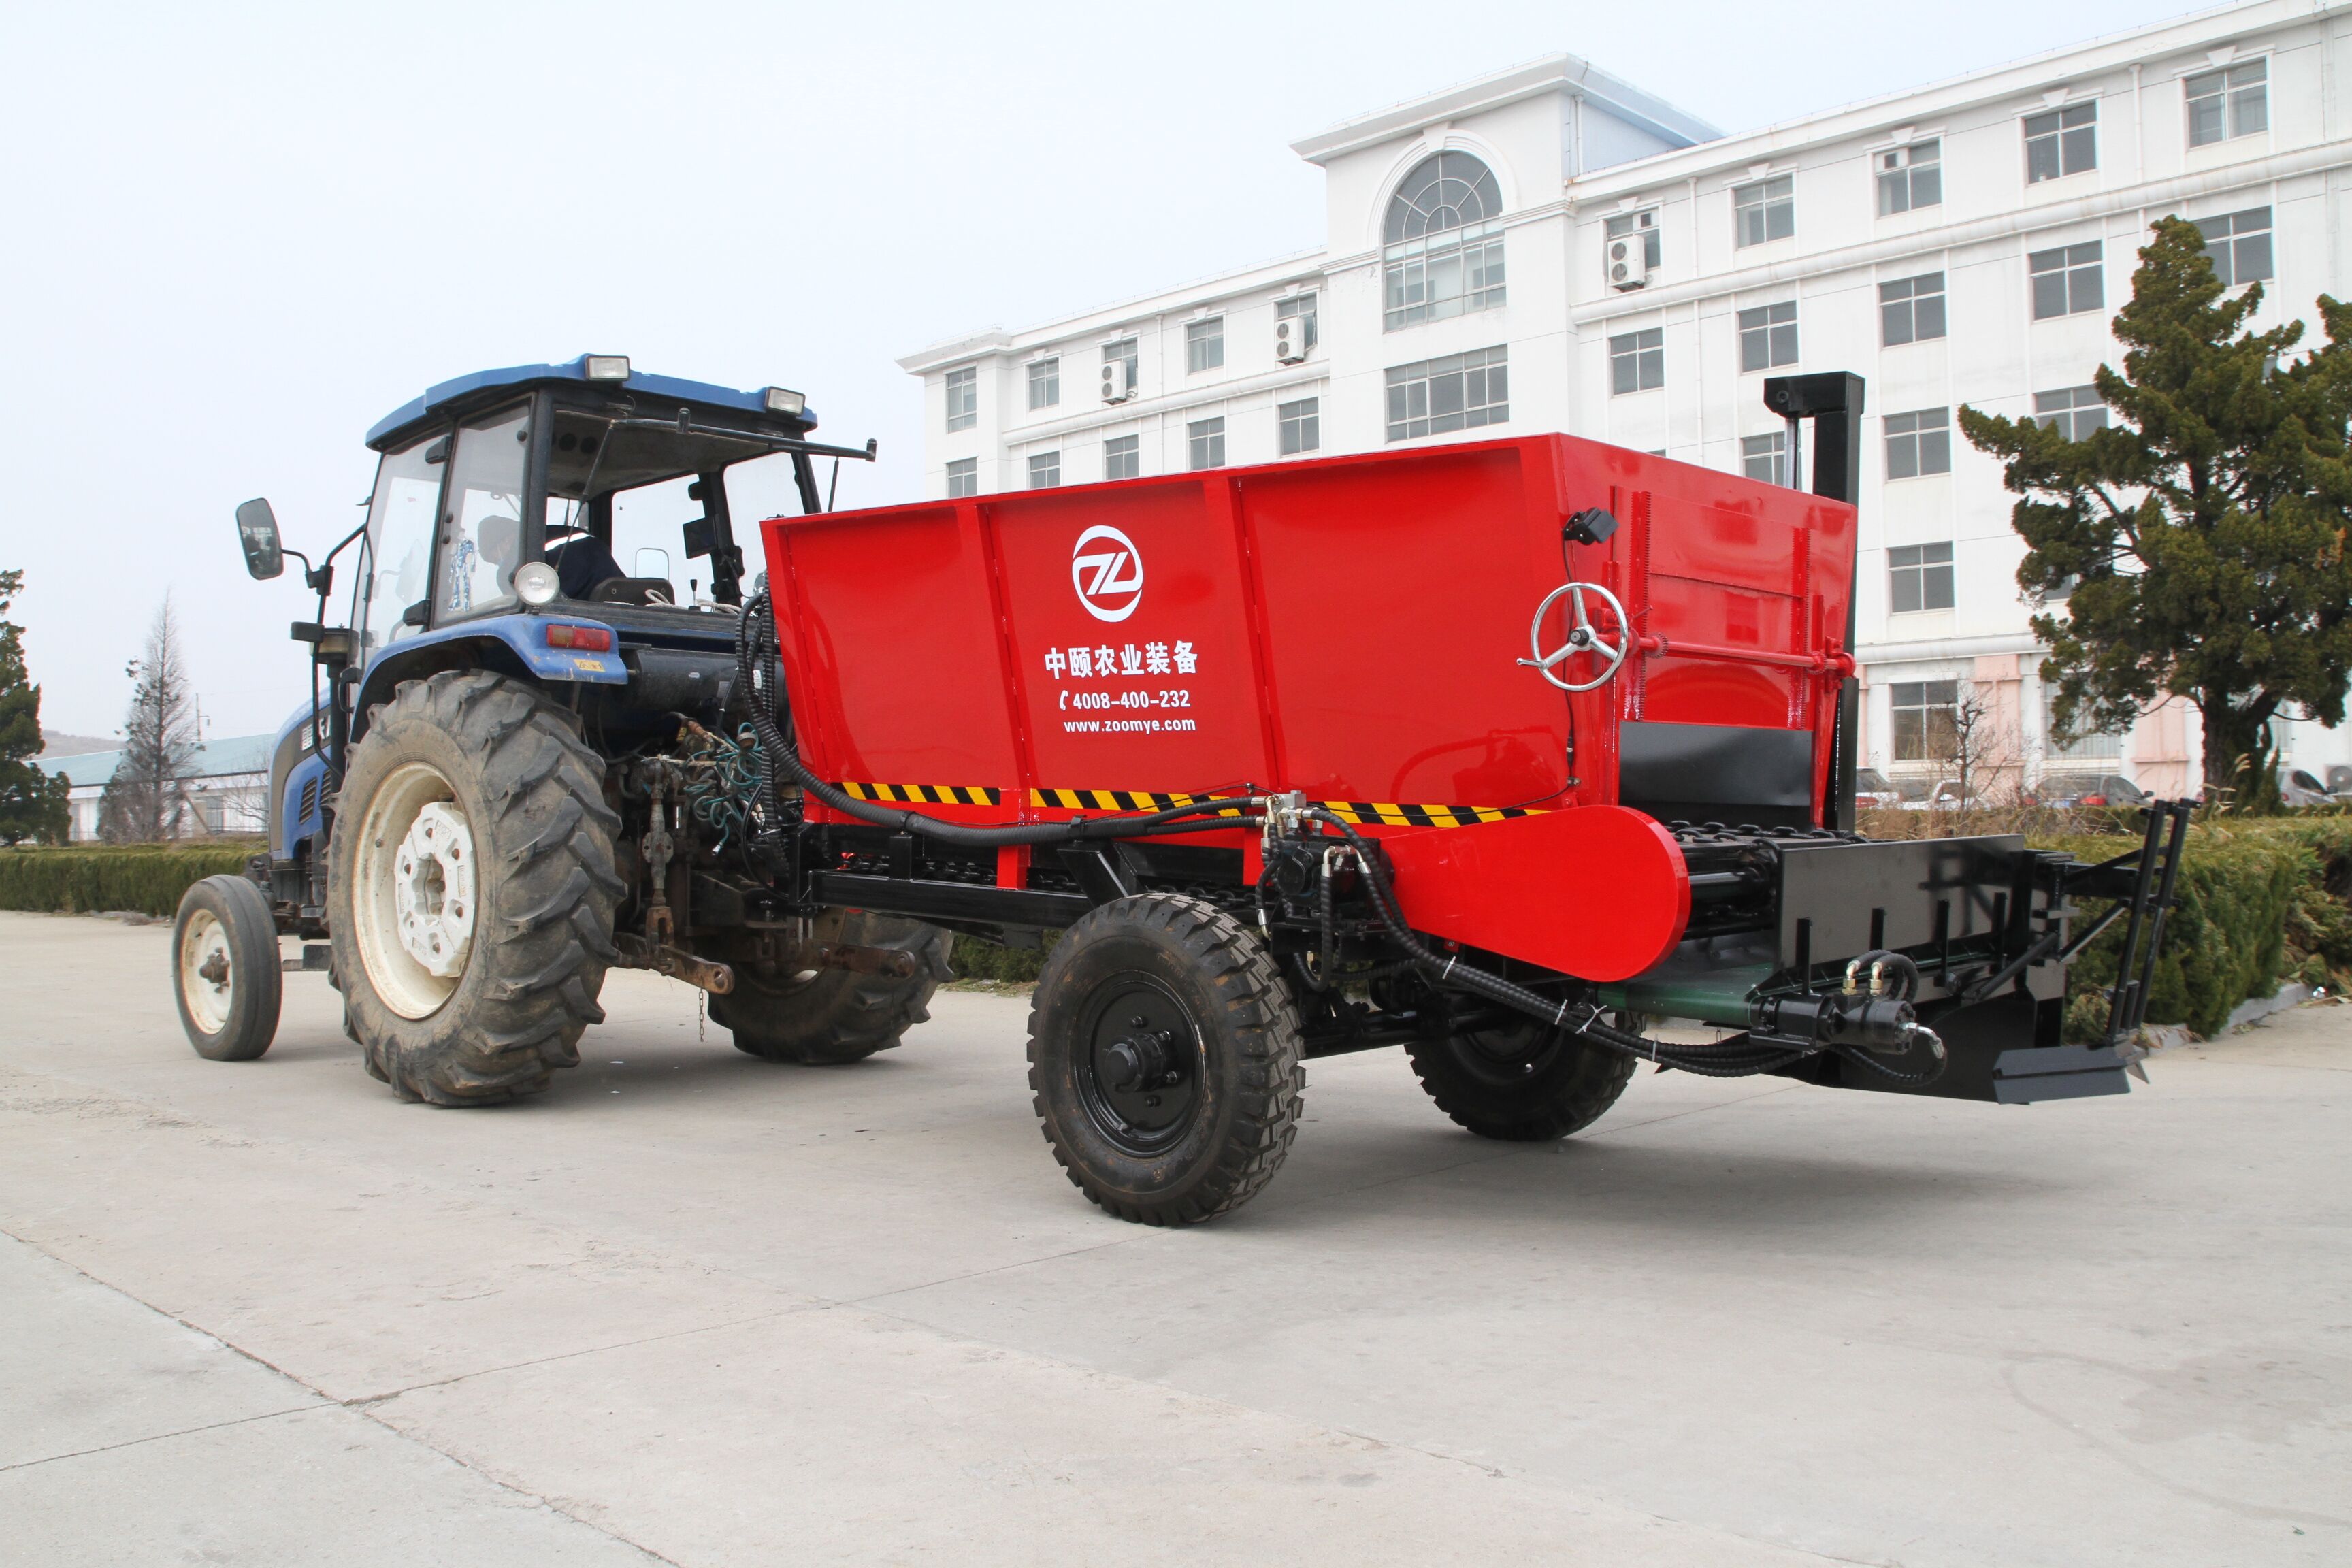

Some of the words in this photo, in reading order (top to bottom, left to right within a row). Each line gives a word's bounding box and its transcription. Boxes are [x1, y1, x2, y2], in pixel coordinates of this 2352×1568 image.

[1044, 640, 1198, 680] 中颐农业装备
[1073, 689, 1191, 710] 4008-400-232
[1063, 719, 1196, 735] www.zoomye.com
